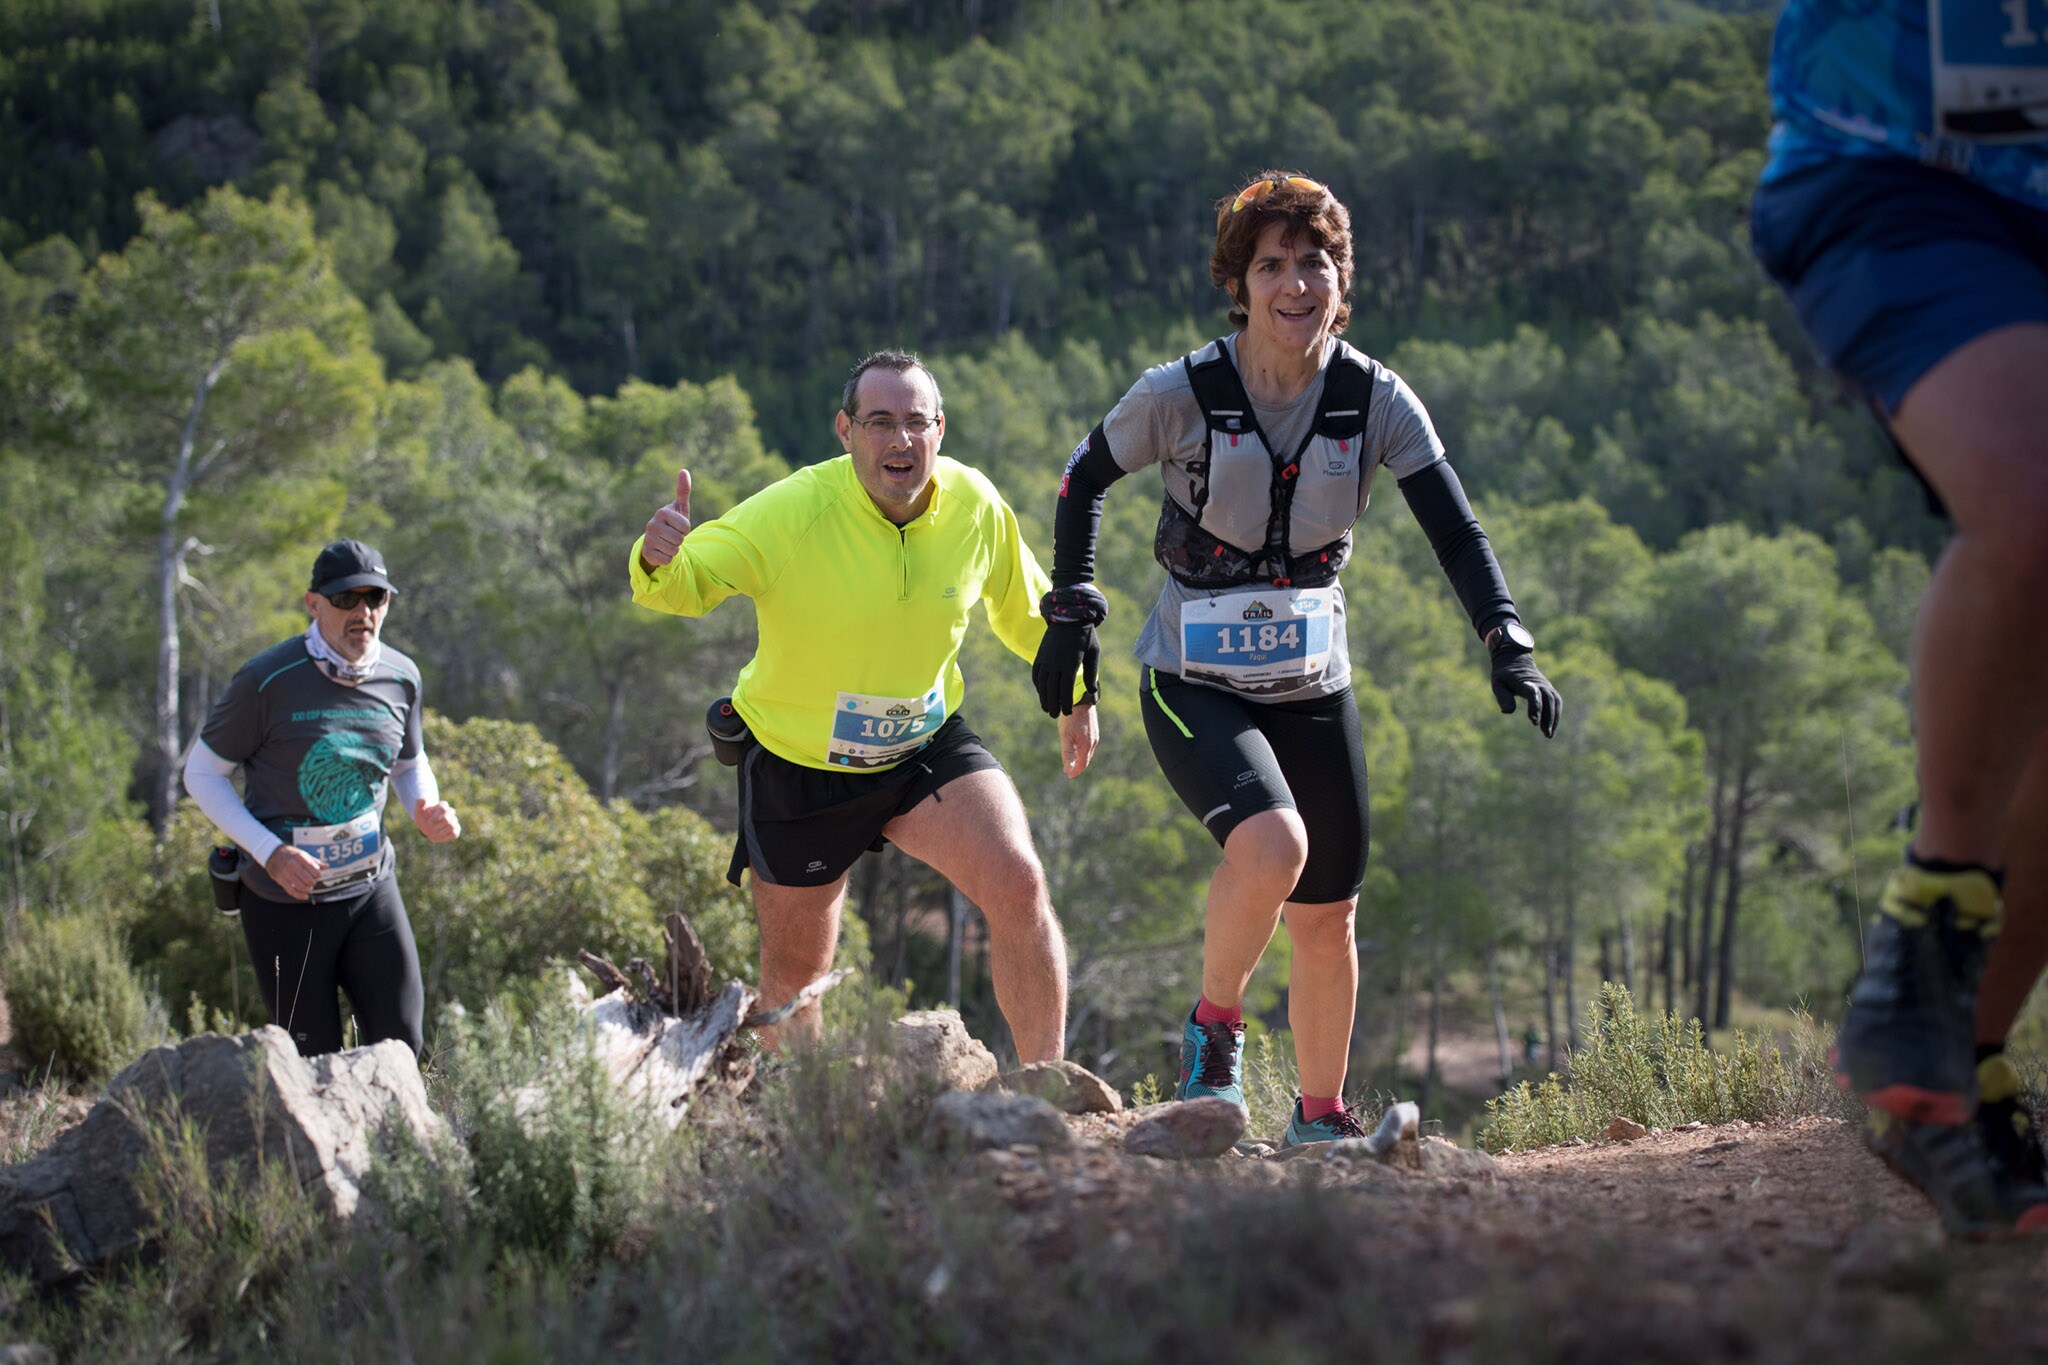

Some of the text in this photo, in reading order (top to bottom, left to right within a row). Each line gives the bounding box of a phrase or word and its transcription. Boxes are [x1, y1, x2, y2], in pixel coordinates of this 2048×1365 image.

[2001, 0, 2048, 47] 1
[1245, 611, 1272, 619] TRAIL
[1217, 623, 1299, 654] 1184
[1249, 653, 1267, 662] Paqui
[860, 715, 928, 738] 1075
[316, 839, 364, 862] 1356
